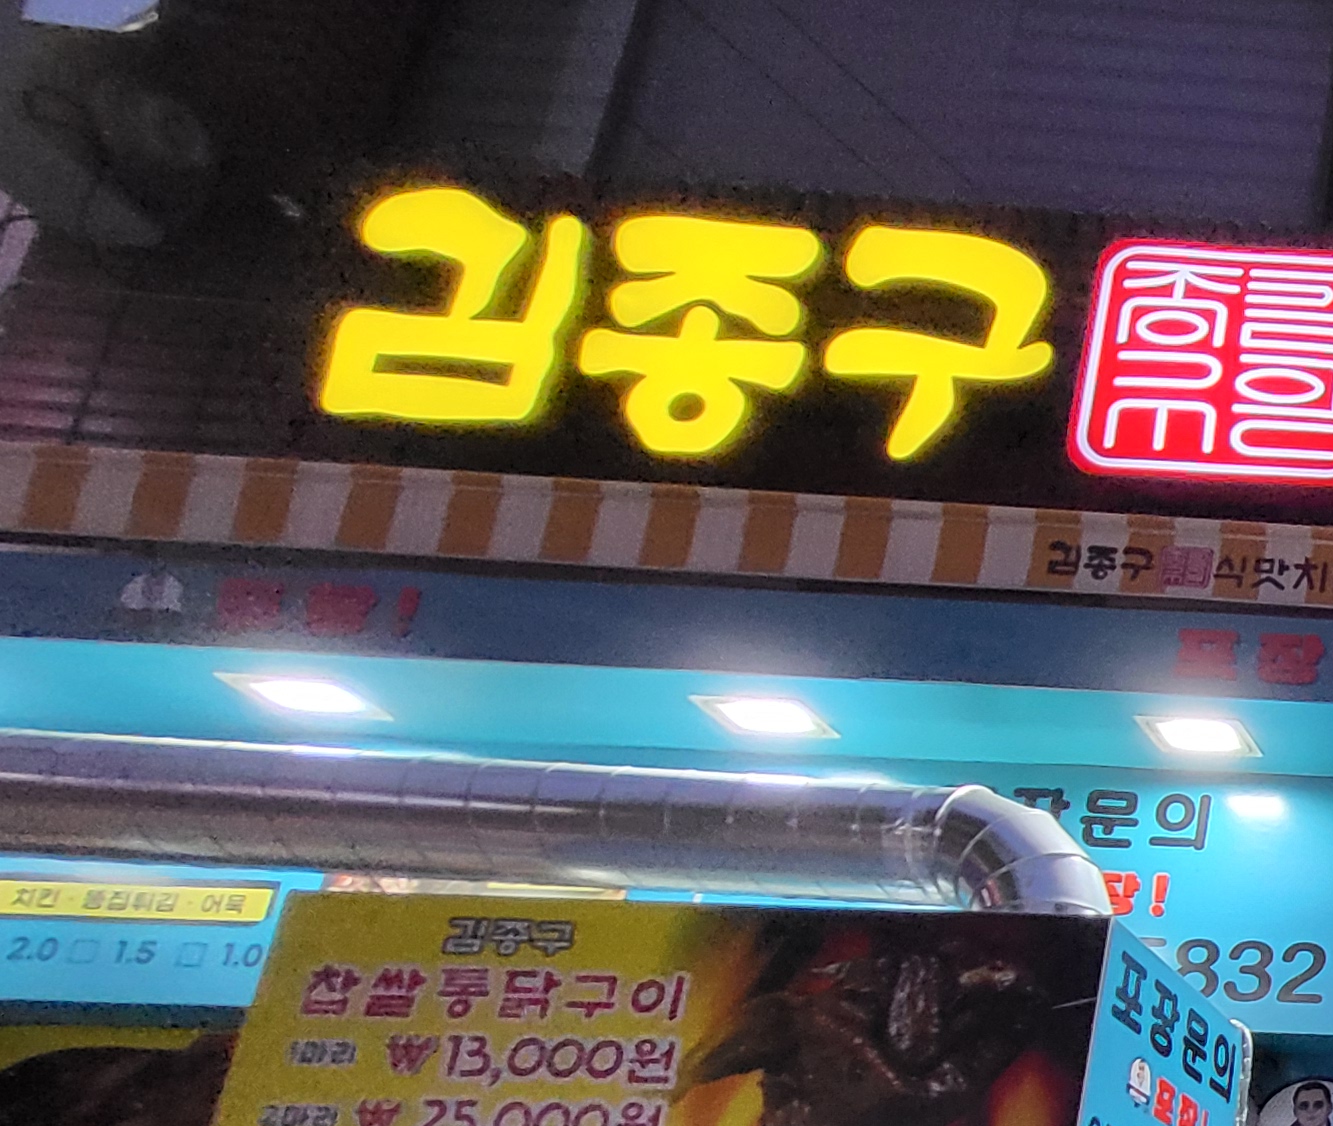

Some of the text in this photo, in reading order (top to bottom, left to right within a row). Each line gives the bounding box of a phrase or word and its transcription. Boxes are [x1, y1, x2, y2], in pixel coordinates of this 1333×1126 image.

[317, 187, 1053, 459] 김종구
[1047, 539, 1155, 582] 김종구
[1104, 871, 1170, 917] 장!
[442, 917, 575, 957] 김종구
[303, 963, 688, 1021] 찹쌀통닭구이
[1140, 937, 1327, 1005] 832
[1111, 950, 1237, 1104] 포장문의
